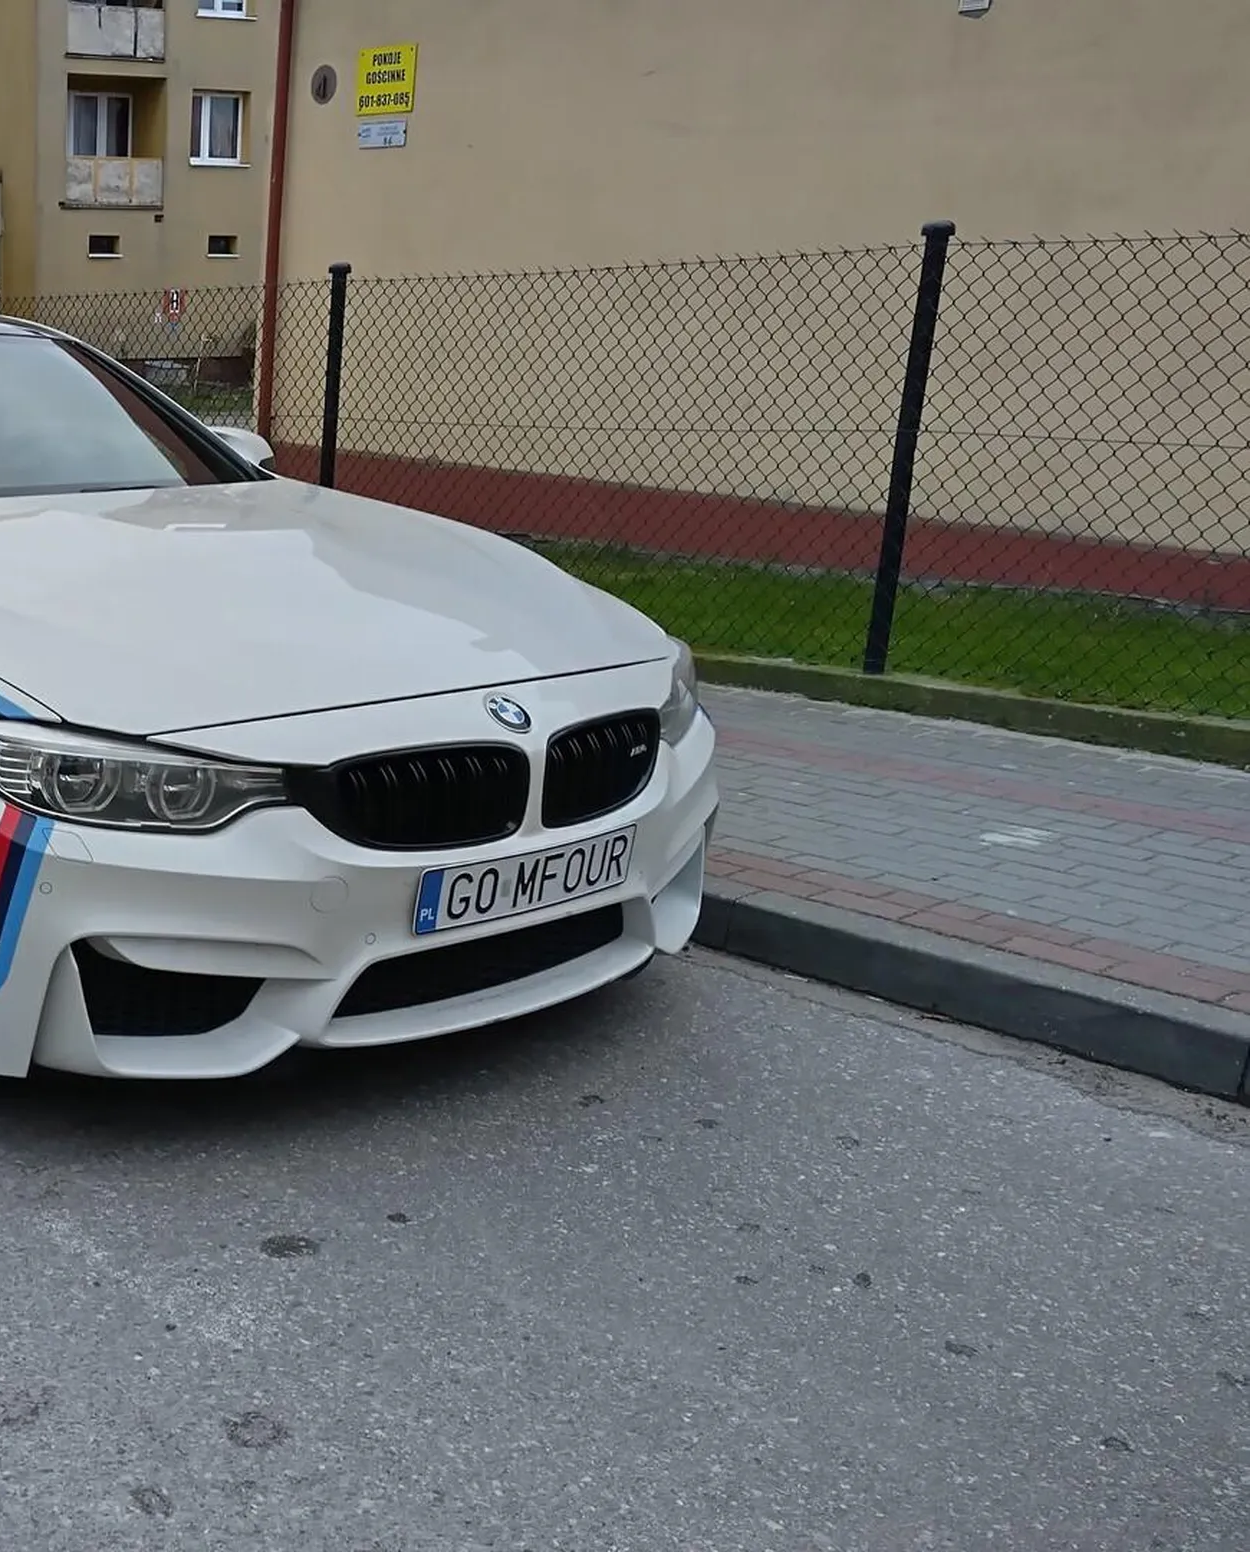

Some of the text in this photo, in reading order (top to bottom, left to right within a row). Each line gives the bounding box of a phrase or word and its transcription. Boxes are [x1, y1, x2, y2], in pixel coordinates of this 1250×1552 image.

[372, 51, 401, 66] POKOJE
[512, 834, 629, 908] MFOUR
[420, 908, 434, 920] PL
